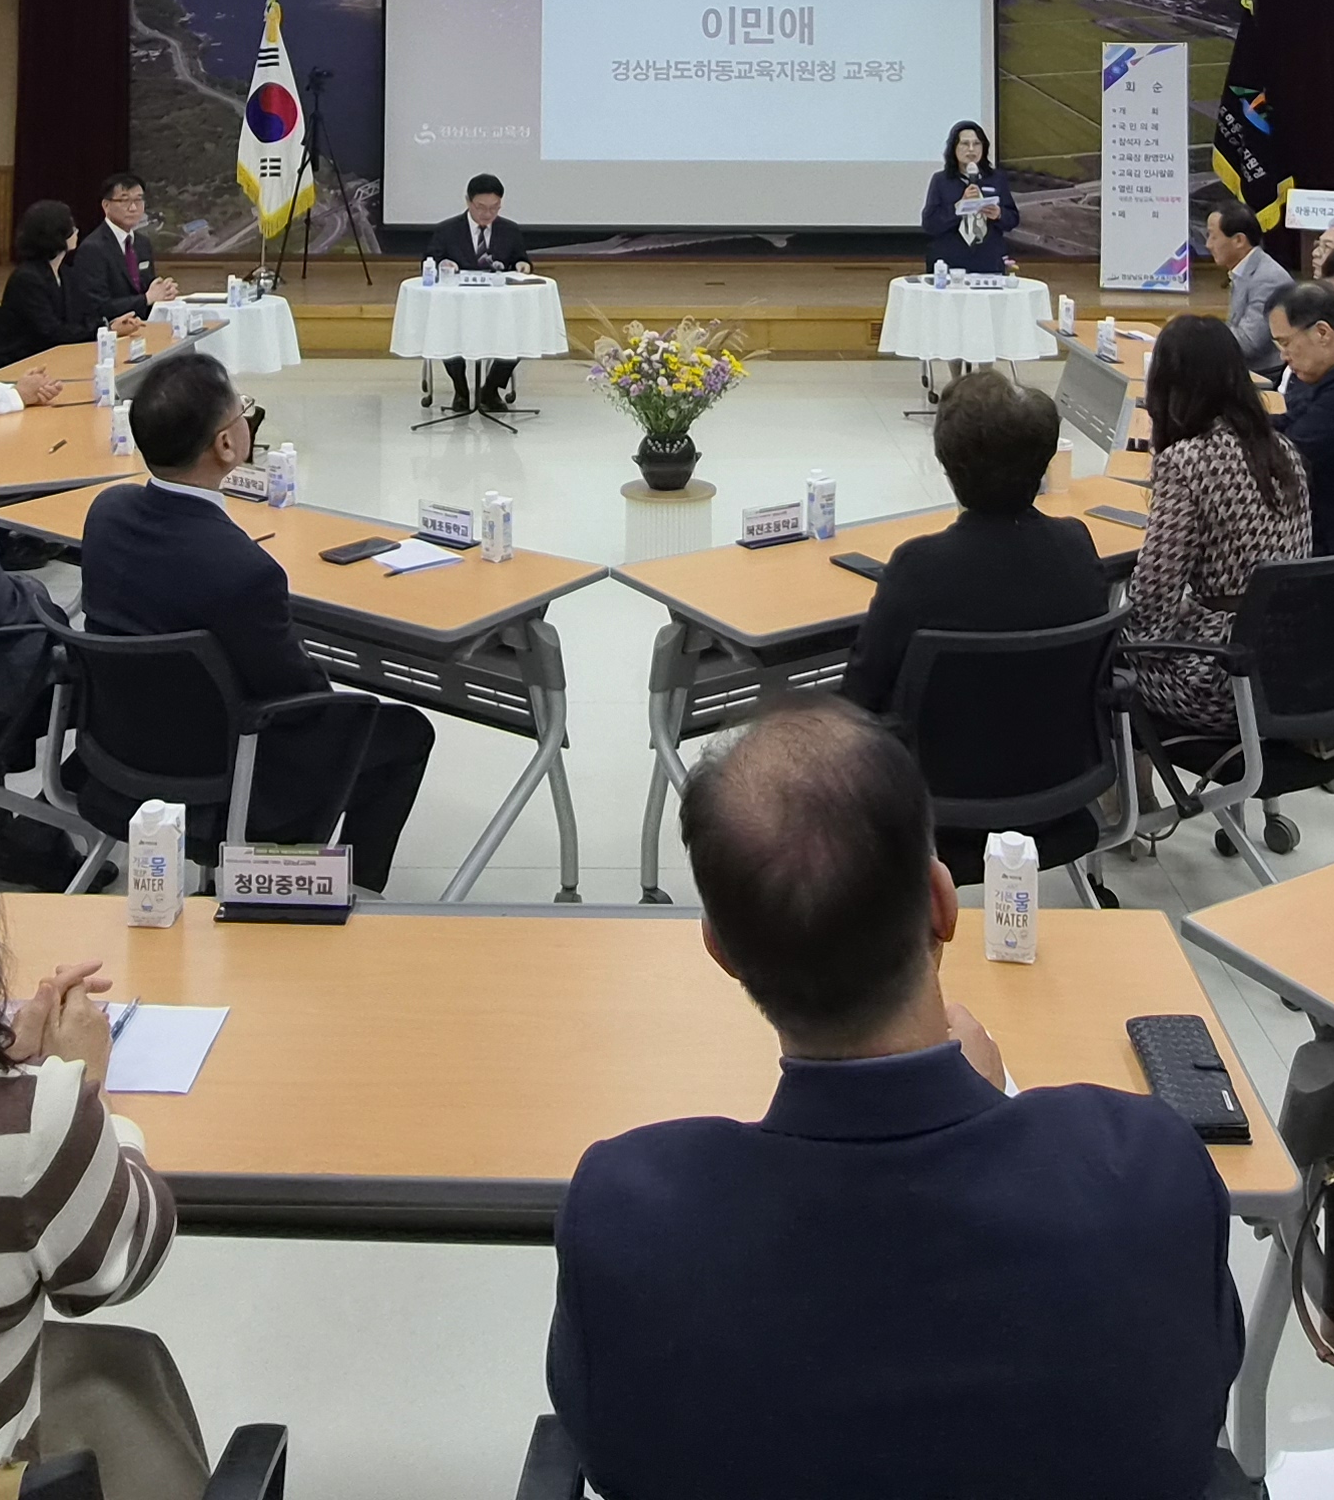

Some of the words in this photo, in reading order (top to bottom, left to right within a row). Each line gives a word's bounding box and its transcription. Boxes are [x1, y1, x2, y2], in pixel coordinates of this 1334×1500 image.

[701, 6, 814, 45] 이민애
[612, 60, 837, 82] 경상남도하동교육지원청
[843, 60, 905, 82] 교육장
[133, 878, 164, 892] WATER
[234, 873, 333, 895] 청암중학교
[995, 911, 1029, 928] WATER
